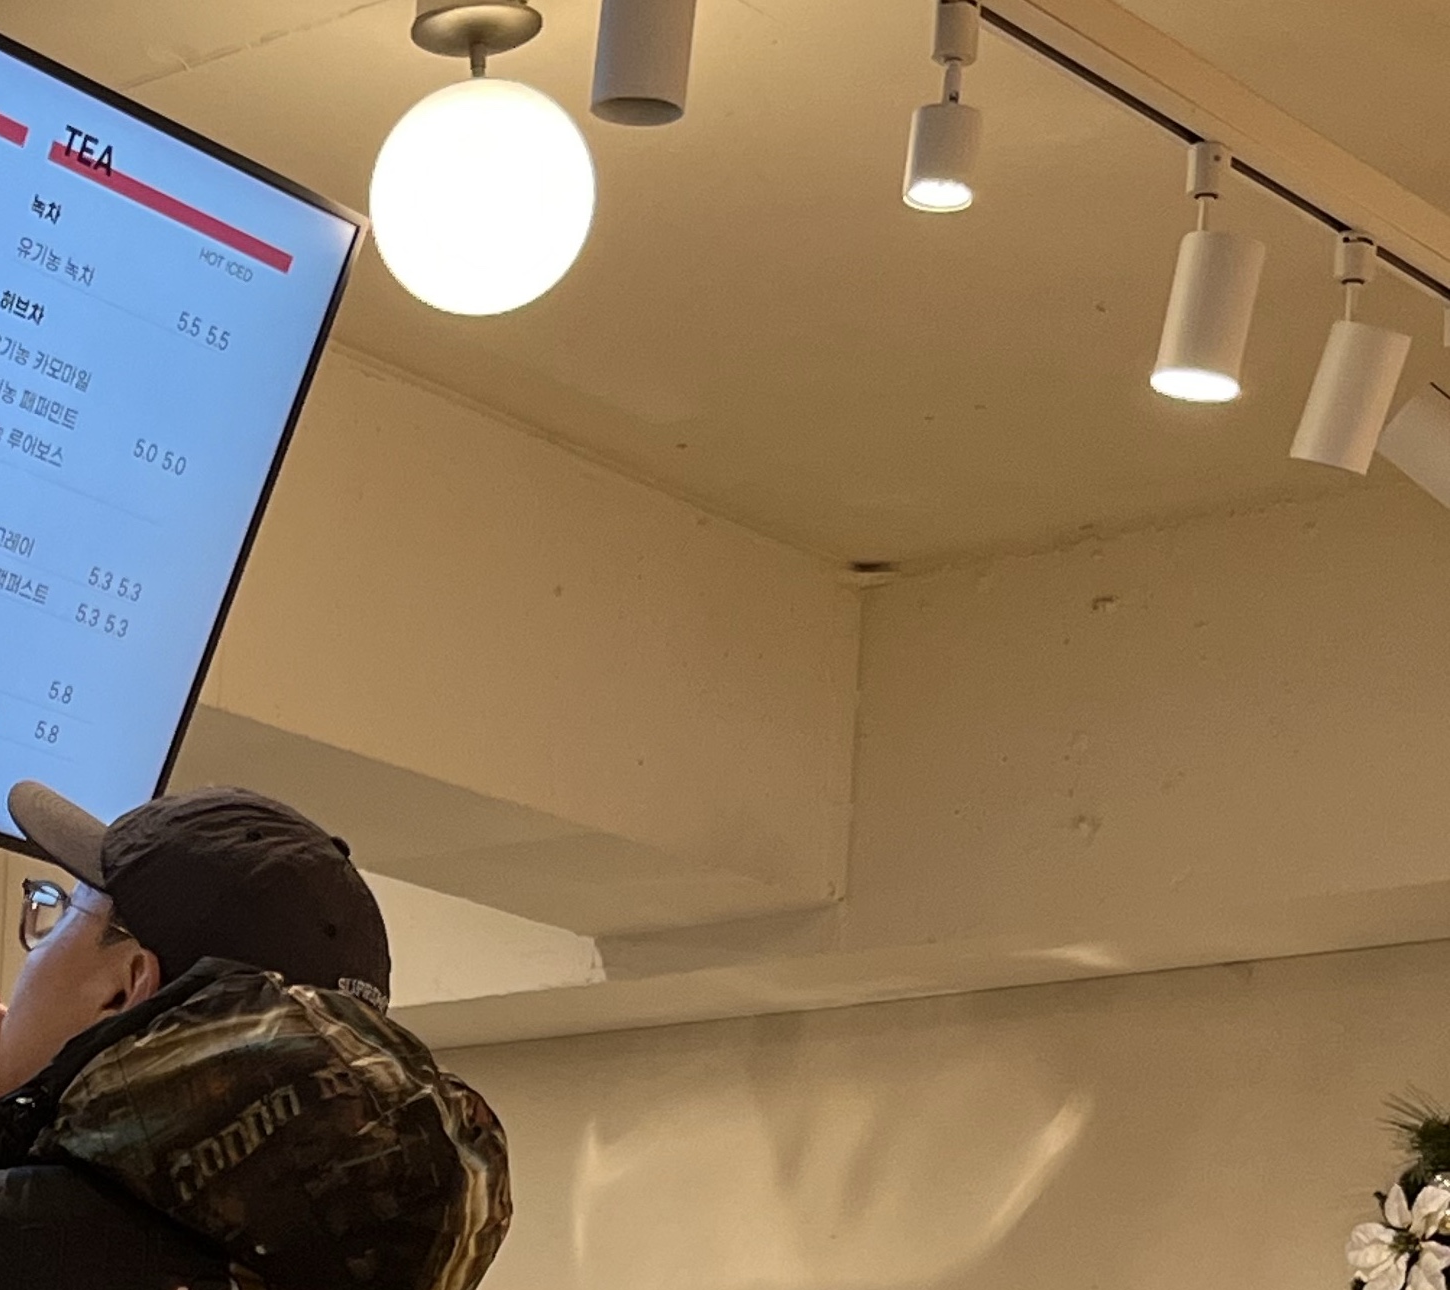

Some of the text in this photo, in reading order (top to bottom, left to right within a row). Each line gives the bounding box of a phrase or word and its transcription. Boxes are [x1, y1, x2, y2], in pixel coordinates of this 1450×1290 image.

[65, 125, 113, 176] TEA
[32, 194, 61, 224] 녹차
[199, 247, 253, 282] HOT ICED
[0, 290, 44, 325] 허브차
[17, 237, 230, 351] 유기농 녹차 5.5 5.5
[33, 350, 92, 392] 카모마일
[133, 438, 158, 462] 5.0
[162, 451, 186, 476] 5.0
[88, 566, 113, 590] 5.3
[117, 577, 142, 601] 5.3
[75, 603, 100, 627] 5.3
[104, 614, 128, 638] 5.3
[48, 681, 73, 704] 5.8
[35, 720, 59, 743] 5.8
